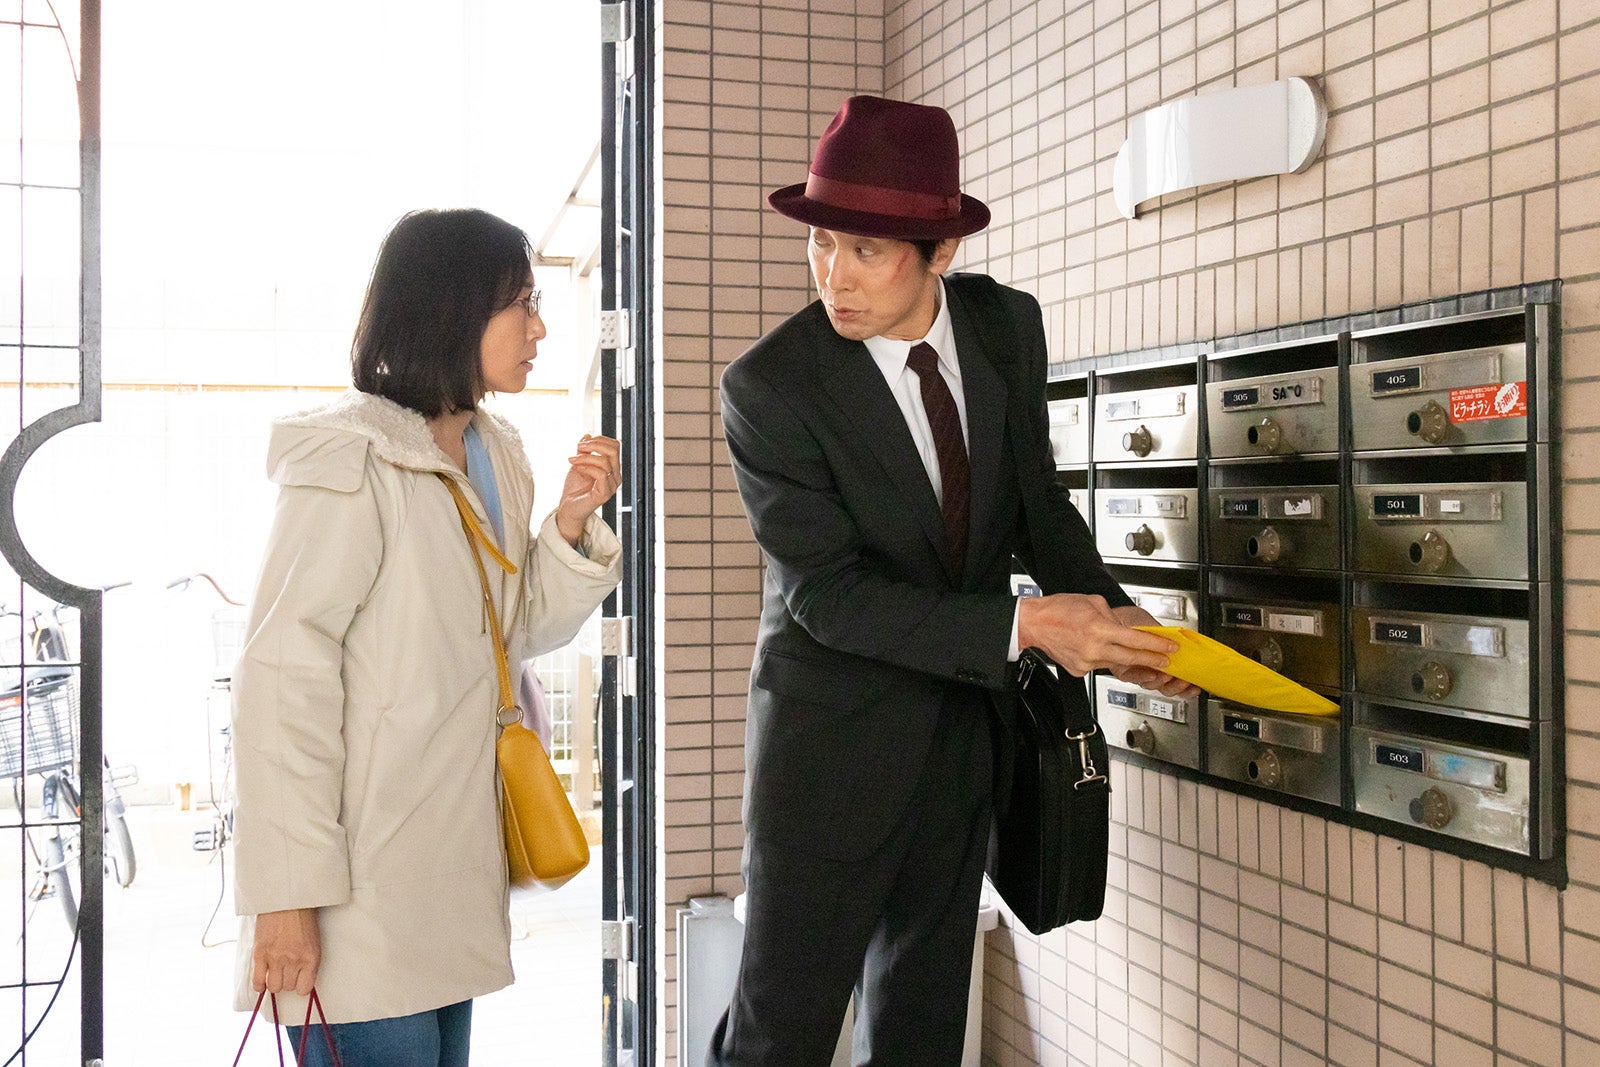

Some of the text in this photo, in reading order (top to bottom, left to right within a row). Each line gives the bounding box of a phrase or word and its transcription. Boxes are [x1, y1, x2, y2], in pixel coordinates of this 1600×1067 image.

[1386, 375, 1406, 385] 405
[1232, 393, 1248, 402] 305
[1233, 503, 1248, 512] 401
[1386, 500, 1405, 509] 501
[1236, 612, 1251, 621] 402
[1388, 629, 1408, 639] 502
[1114, 695, 1127, 703] 303
[1233, 721, 1249, 732] 403
[1388, 752, 1409, 764] 503
